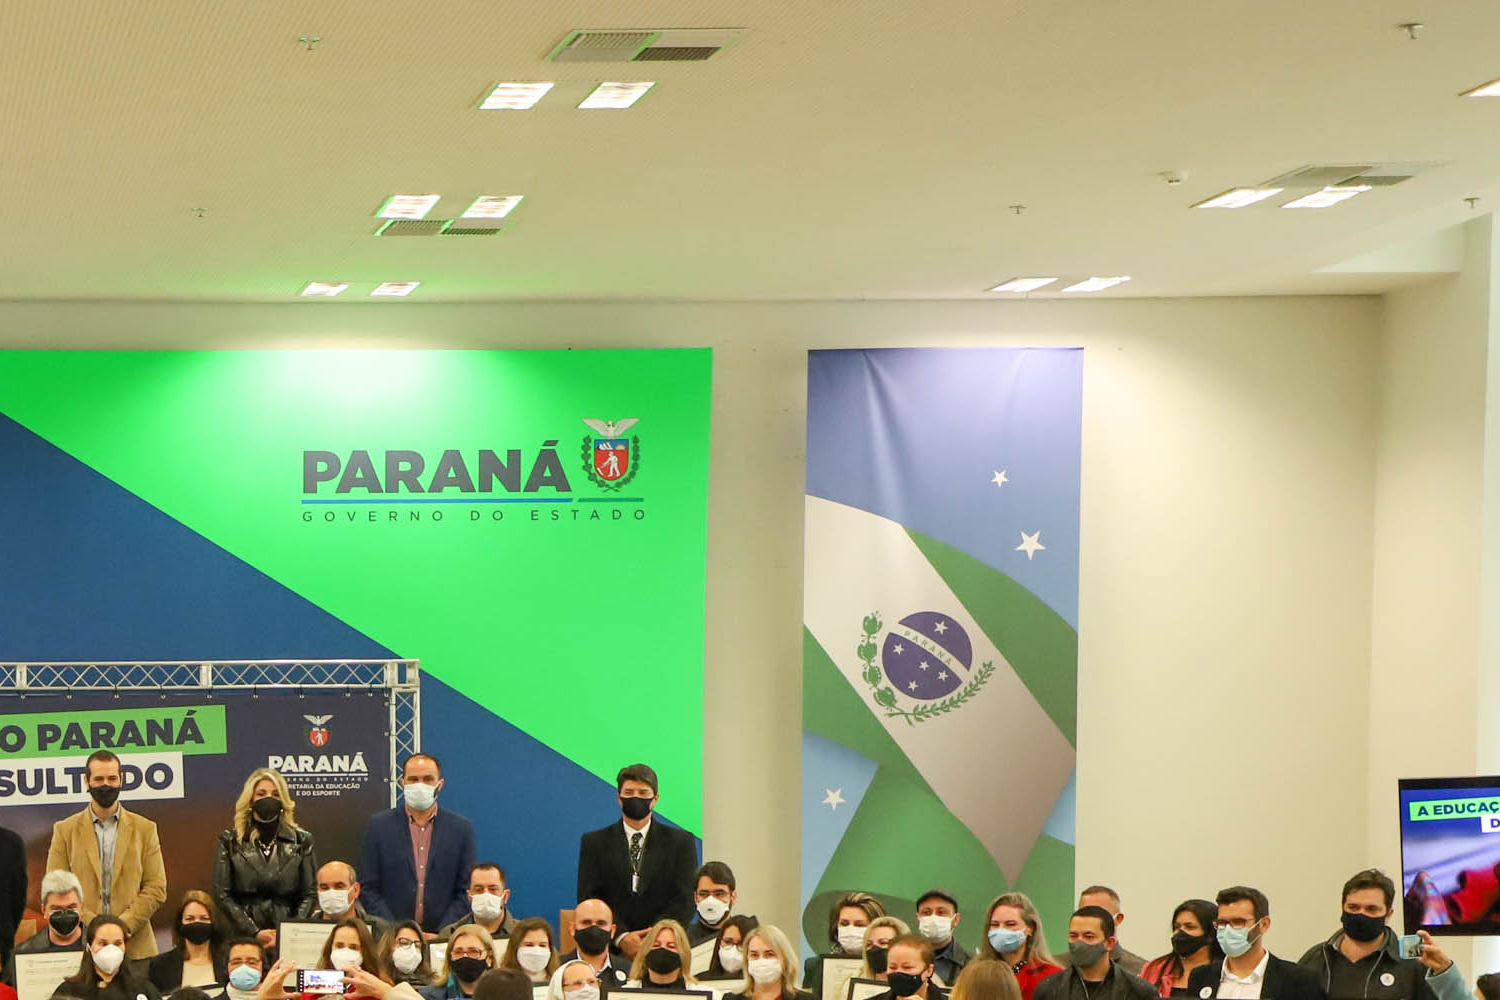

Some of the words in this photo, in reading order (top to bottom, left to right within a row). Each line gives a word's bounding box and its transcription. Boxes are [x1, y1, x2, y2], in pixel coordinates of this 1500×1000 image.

[303, 439, 572, 494] PARANÁ
[302, 510, 444, 522] GOVERNO
[470, 509, 503, 521] DO
[531, 508, 646, 521] ESTADO
[36, 709, 205, 751] PARANÁ
[268, 751, 368, 773] PARANÁ
[325, 782, 361, 790] EDUCAÇÃO
[1417, 805, 1429, 816] A
